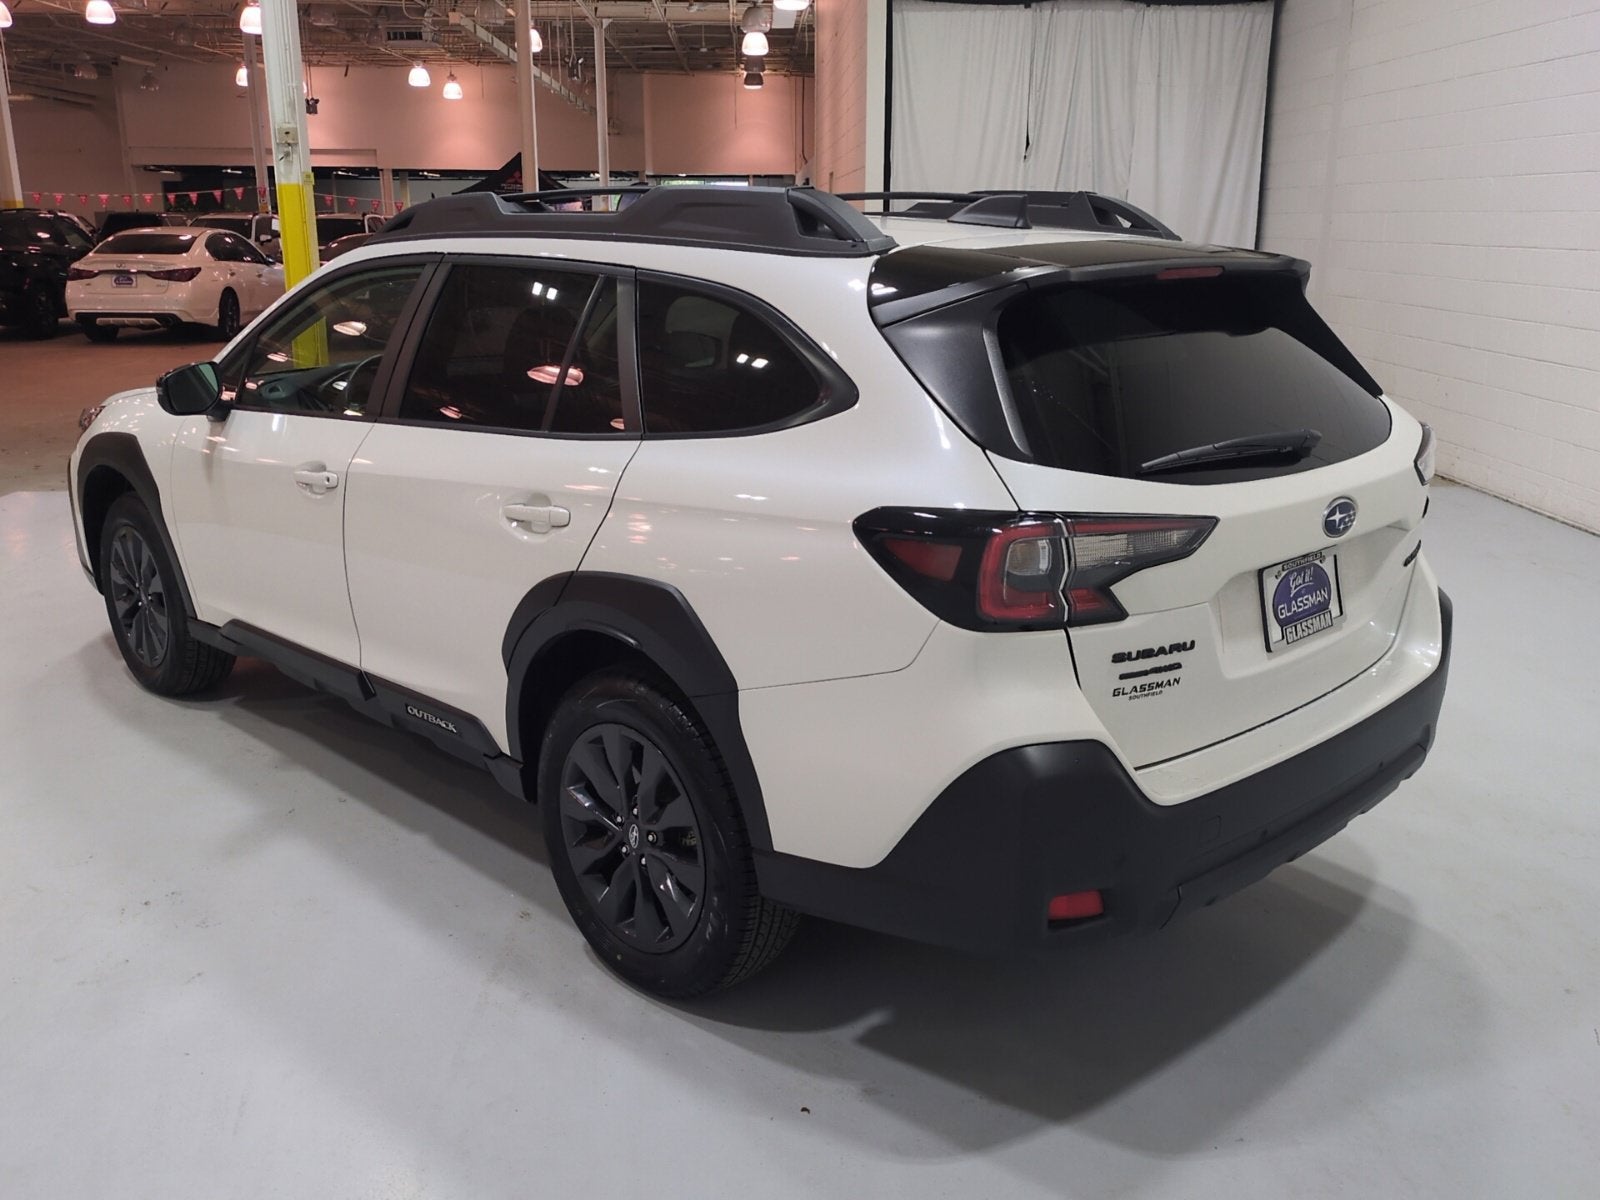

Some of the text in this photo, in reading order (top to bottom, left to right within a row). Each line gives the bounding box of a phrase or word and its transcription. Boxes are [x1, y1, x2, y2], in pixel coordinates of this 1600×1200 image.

[1278, 587, 1328, 619] GLASSMAN
[1286, 611, 1332, 642] GLASSMAN
[1111, 640, 1195, 663] SUBARU
[1112, 677, 1181, 697] GLASSMAN
[1128, 690, 1163, 701] SOUTHFIELD
[407, 706, 456, 733] OUTBACK
